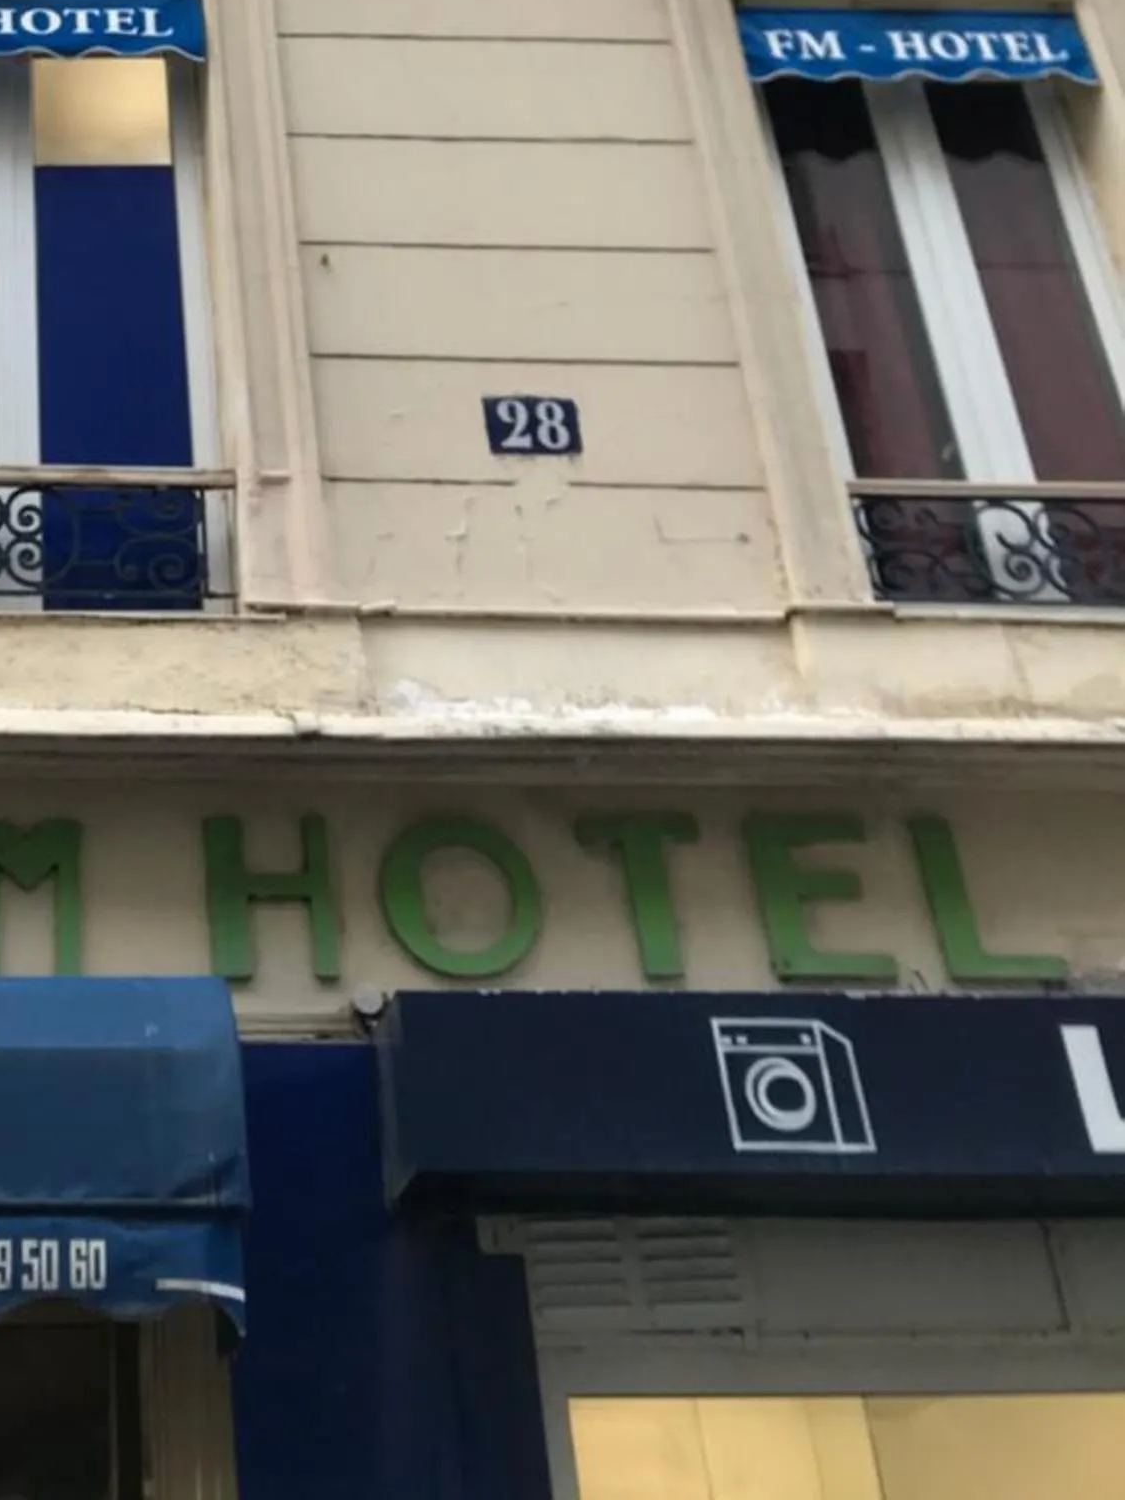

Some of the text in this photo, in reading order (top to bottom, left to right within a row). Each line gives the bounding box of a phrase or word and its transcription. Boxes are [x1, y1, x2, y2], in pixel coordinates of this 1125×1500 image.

[764, 29, 846, 61] FM
[885, 30, 1069, 63] HOTEL
[496, 399, 571, 449] 28
[201, 811, 1067, 988] HOTEL
[21, 1238, 59, 1291] 50
[70, 1238, 107, 1291] 60
